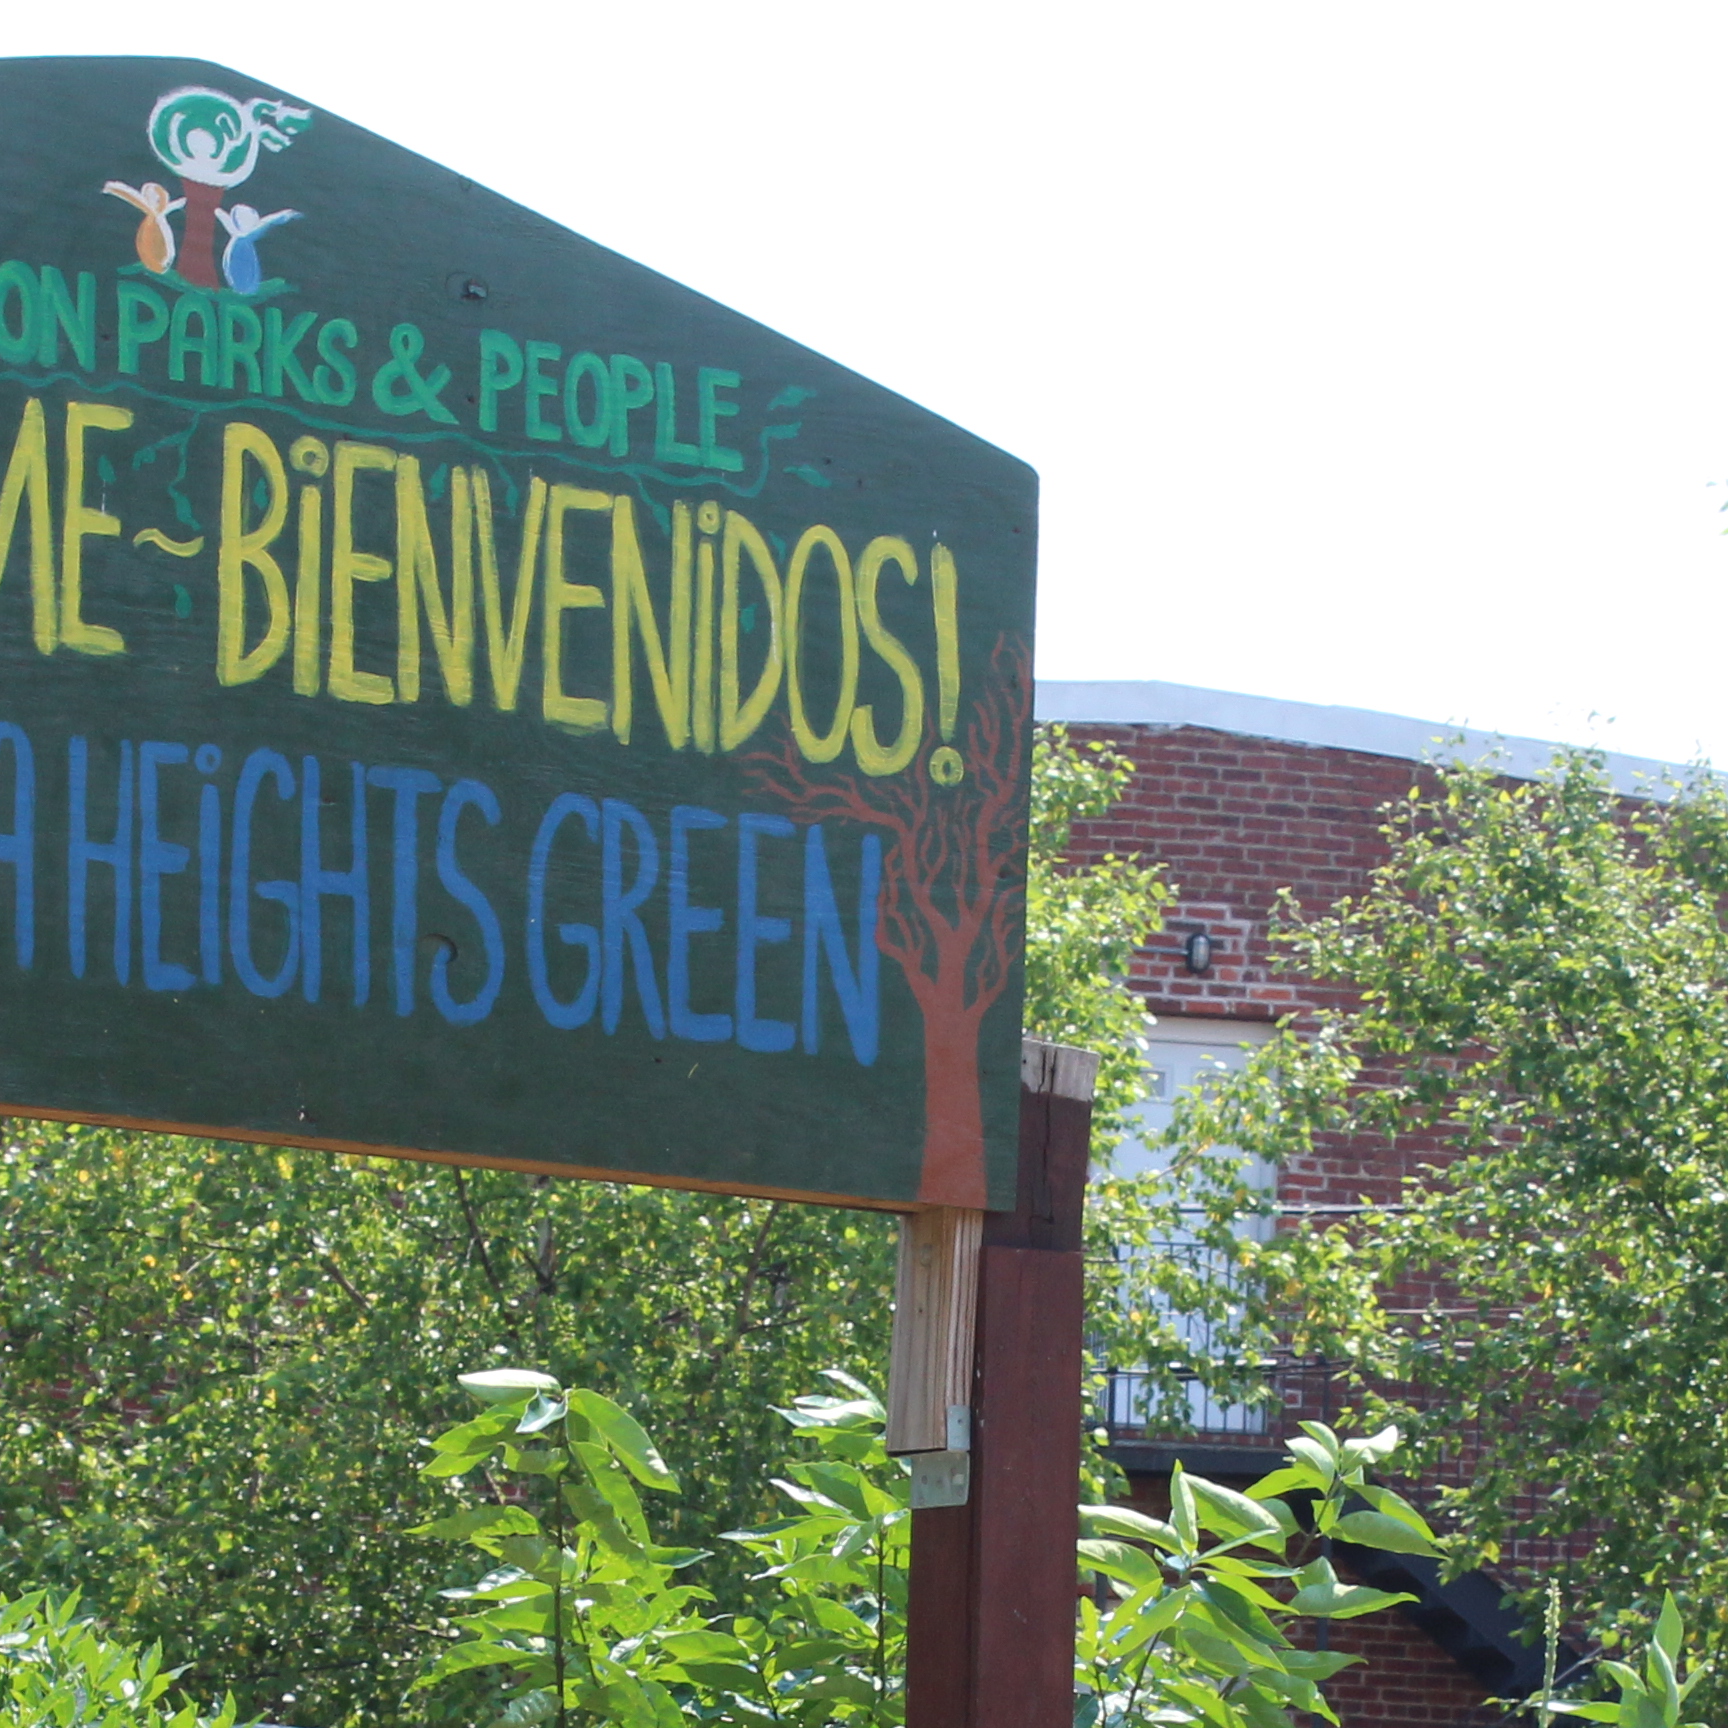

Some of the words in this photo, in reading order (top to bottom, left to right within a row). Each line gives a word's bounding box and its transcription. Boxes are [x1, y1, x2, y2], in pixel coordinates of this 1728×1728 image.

[117, 280, 358, 406] PARKS
[372, 322, 460, 425] &
[478, 328, 744, 471] PEOPLE
[526, 791, 883, 1067] GREEN
